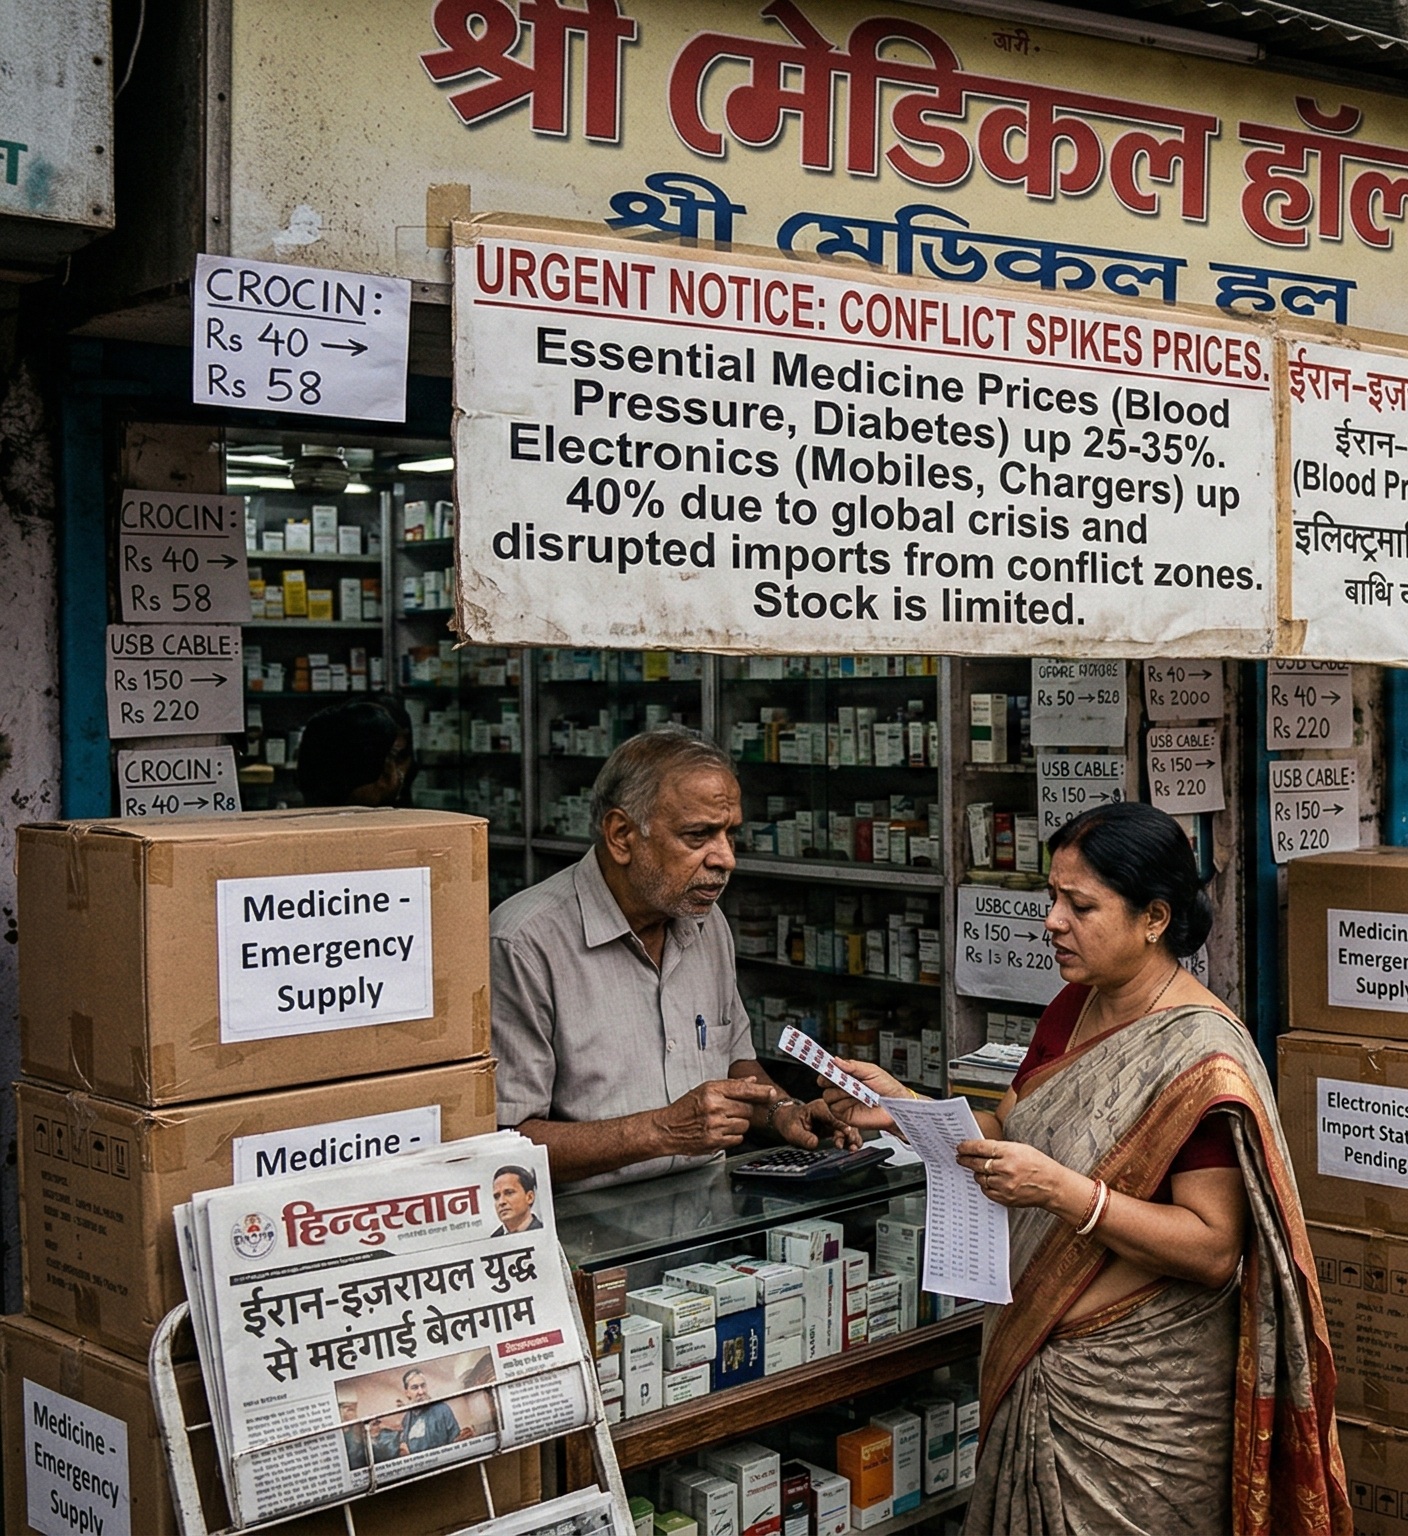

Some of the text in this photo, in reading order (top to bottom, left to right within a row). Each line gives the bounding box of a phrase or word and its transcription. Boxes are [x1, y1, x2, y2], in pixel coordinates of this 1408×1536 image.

[206, 268, 383, 324] CROCIN:
[473, 243, 1269, 389] URGENT NOTICE: CONFLICT SPIKES PRICES.
[206, 317, 309, 358] Rs 40
[208, 363, 322, 406] Rs 58
[537, 319, 1230, 429] Essential Medicine Prices (Blood
[574, 371, 1225, 469] Pressure, Diabetes) up 25-35%.
[510, 416, 1240, 517] Electronics (Mobiles, Chargers) up
[1293, 458, 1376, 498] (Blood
[121, 500, 237, 532] CROCIN:
[566, 476, 1147, 545] 40% due to global crisis and
[124, 544, 199, 573] Rs 40
[492, 522, 1263, 591] disrupted imports from conflict zones.
[131, 583, 212, 613] Rs 58
[753, 581, 1085, 626] Stock is limited.
[111, 633, 239, 656] USB CABLE:
[114, 669, 183, 692] Rs 150
[1147, 665, 1186, 684] Rs 40
[1037, 689, 1075, 707] Rs 50
[1149, 688, 1211, 706] Rs 2000
[1271, 684, 1317, 708] Rs 40
[120, 699, 200, 724] Rs 220
[1176, 733, 1215, 748] CABLE:
[1273, 715, 1330, 739] Rs 220
[124, 758, 223, 784] CROCIN:
[1041, 760, 1124, 777] USB CABLE:
[1151, 756, 1193, 773] Rs 150
[1272, 766, 1355, 789] USB CABLE:
[1042, 785, 1086, 803] Rs 150
[1154, 778, 1206, 797] Rs 220
[125, 794, 180, 816] Rs 40
[1044, 810, 1062, 828] Rs
[1274, 800, 1321, 822] Rs 150
[1277, 828, 1330, 852] Rs 220
[243, 887, 390, 923] Medicine
[975, 896, 1012, 915] USBC
[963, 921, 980, 941] Rs
[984, 922, 1011, 943] 150
[241, 934, 414, 970] Emergency
[965, 945, 1054, 971] Rs Rs 220
[277, 975, 384, 1015] Supply
[1322, 1116, 1375, 1140] Import
[256, 1133, 400, 1178] Medicine
[1344, 1146, 1408, 1175] Pending
[281, 1184, 481, 1248] हिन्दुस्तान
[239, 1258, 475, 1340] ईरान-इज़रायल
[481, 1246, 537, 1293] युद्ध
[263, 1295, 536, 1384] से महंगाई बेलगाम
[33, 1401, 105, 1461] Medicine
[34, 1436, 119, 1514] Emergency
[50, 1489, 104, 1536] Supply
